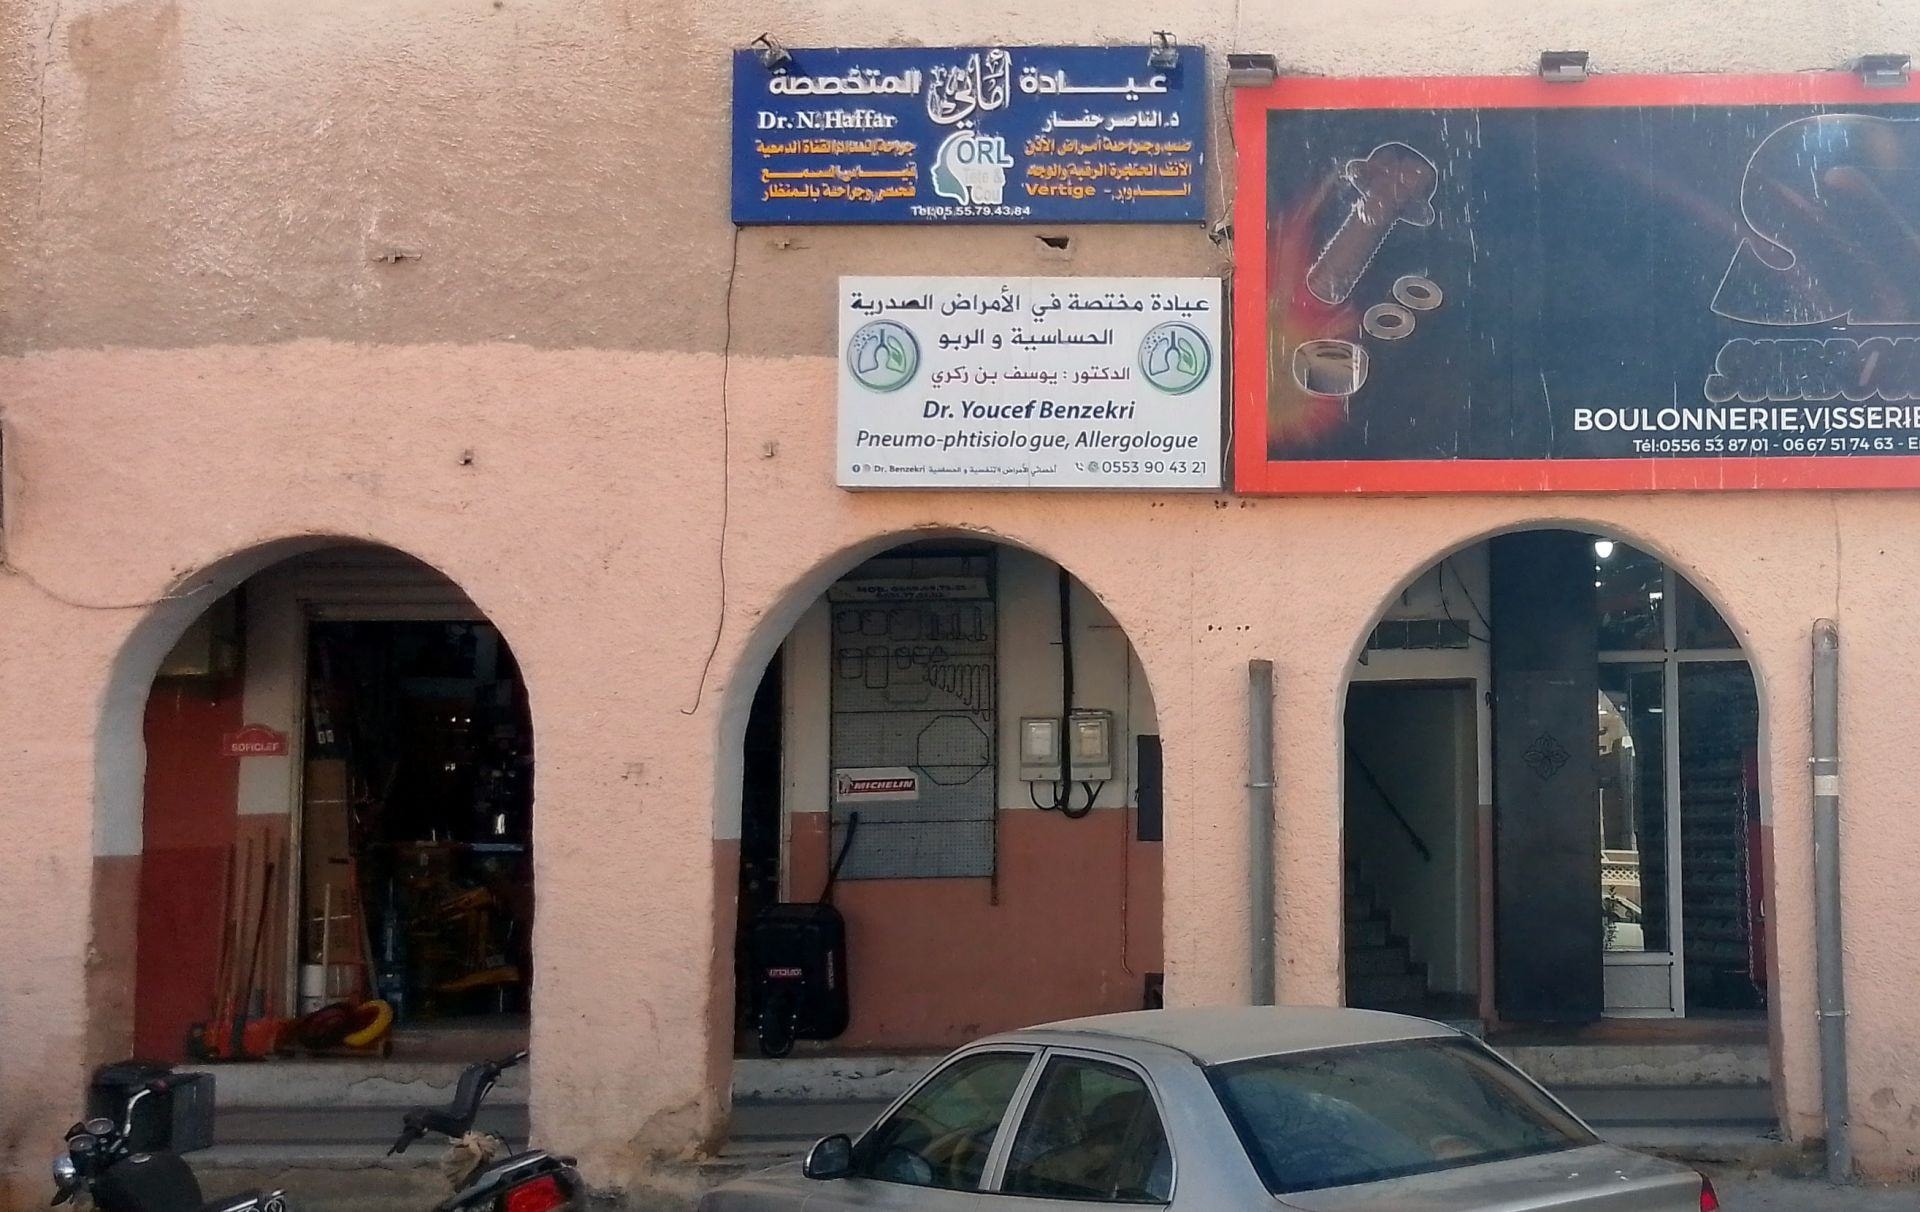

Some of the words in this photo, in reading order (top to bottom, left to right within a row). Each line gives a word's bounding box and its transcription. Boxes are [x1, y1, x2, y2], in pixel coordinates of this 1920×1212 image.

[769, 66, 922, 96] المتخصصة
[757, 111, 793, 129] Dr.
[797, 111, 820, 129] N.
[825, 110, 896, 130] Haffar
[1105, 110, 1161, 132] الناصر
[957, 140, 1011, 164] ORL
[1026, 183, 1096, 199] Vertige
[850, 292, 933, 316] الصدرية
[941, 285, 1020, 316] الأمراض
[1031, 293, 1062, 323] في
[1067, 294, 1144, 313] مختصة
[1150, 294, 1210, 317] عيادة
[938, 329, 984, 351] الربو
[992, 335, 1002, 349] و
[1011, 328, 1114, 351] الحساسية
[931, 366, 969, 388] زكري
[975, 367, 998, 385] بن
[1003, 366, 1058, 385] يوسف
[1072, 366, 1130, 384] الدكتور
[923, 401, 954, 419] Dr.
[962, 400, 1037, 419] Youcef
[1039, 400, 1136, 420] Benzekri
[856, 430, 1070, 452] Pneumo-phtisiologue,
[1074, 430, 1198, 452] Allergologue
[1633, 439, 1700, 452] Tél:0556
[1705, 439, 1725, 452] 53
[1728, 439, 1748, 451] 87
[1752, 438, 1769, 452] 01
[1830, 438, 1846, 451] 51
[1850, 438, 1869, 451] 74
[1873, 438, 1894, 450] 63
[874, 465, 887, 473] Dr.
[889, 464, 926, 473] Benzekri
[1102, 461, 1139, 474] 0553
[1144, 461, 1165, 474] 90
[1169, 461, 1187, 474] 43
[1192, 461, 1206, 474] 21
[854, 780, 913, 790] MICHELIN
